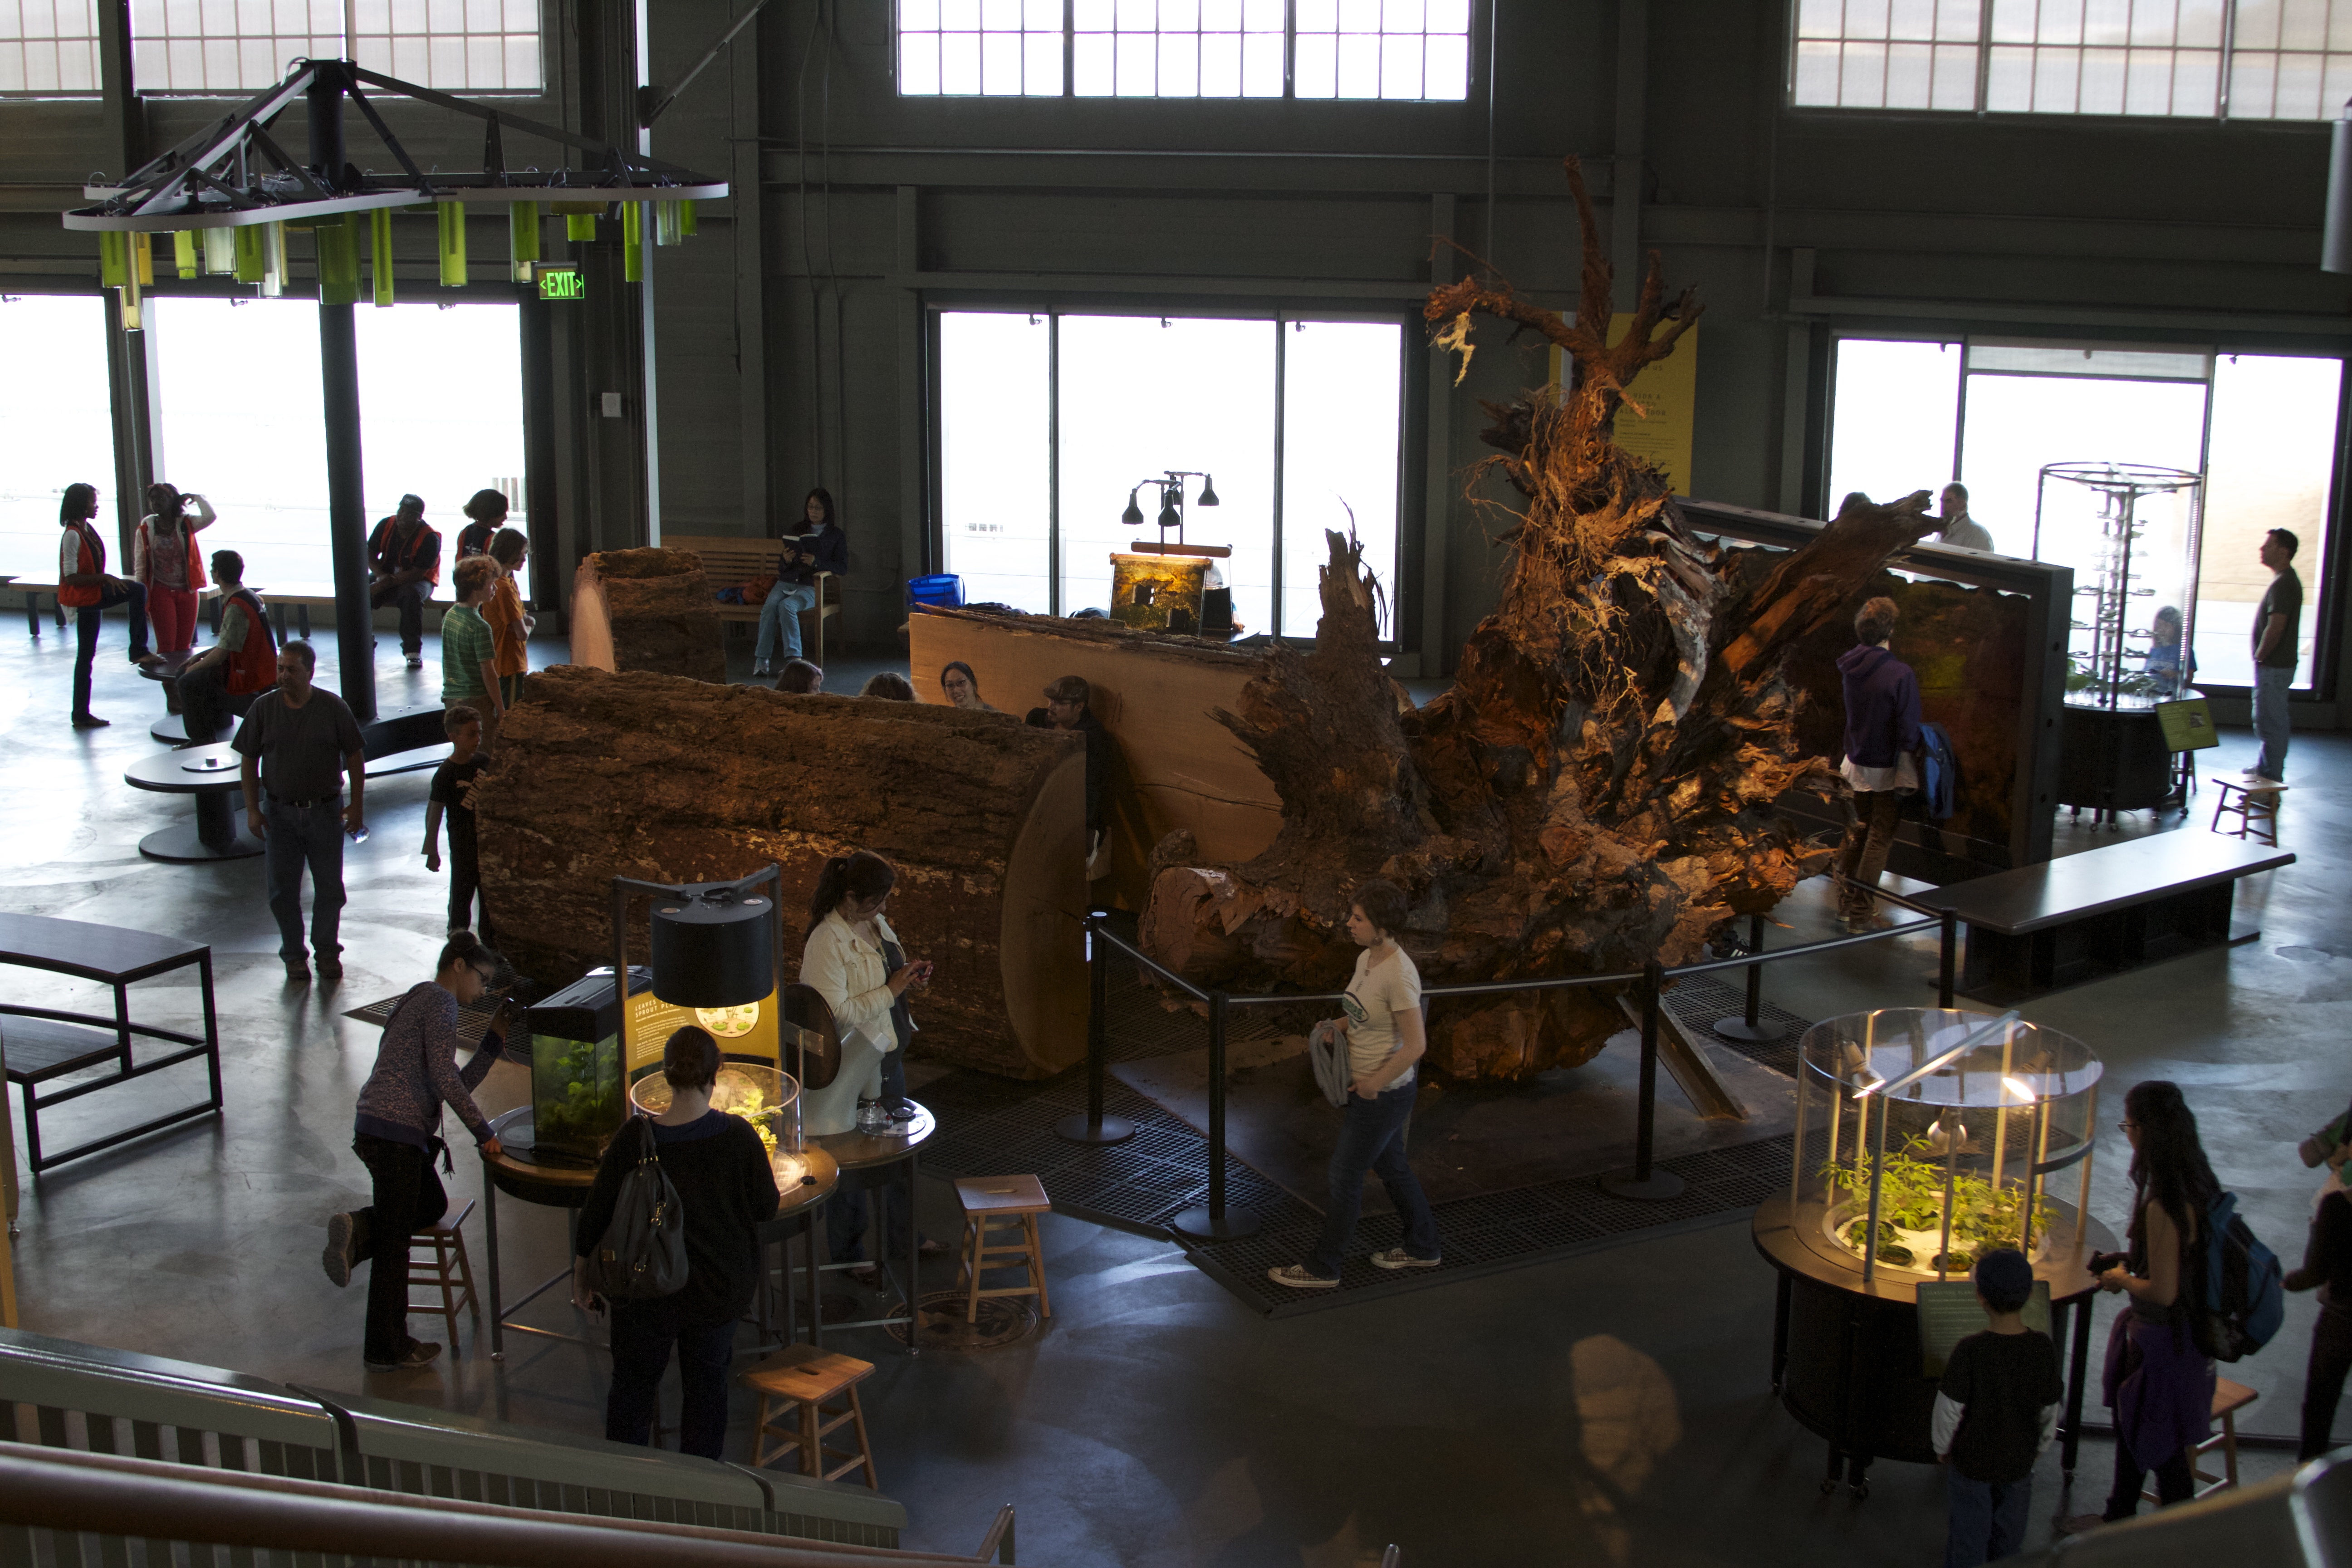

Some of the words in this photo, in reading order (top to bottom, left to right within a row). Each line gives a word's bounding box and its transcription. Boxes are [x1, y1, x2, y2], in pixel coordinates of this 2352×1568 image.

[546, 272, 575, 297] EXIT
[635, 999, 656, 1011] LEAVES
[635, 1005, 657, 1018] SPROUT
